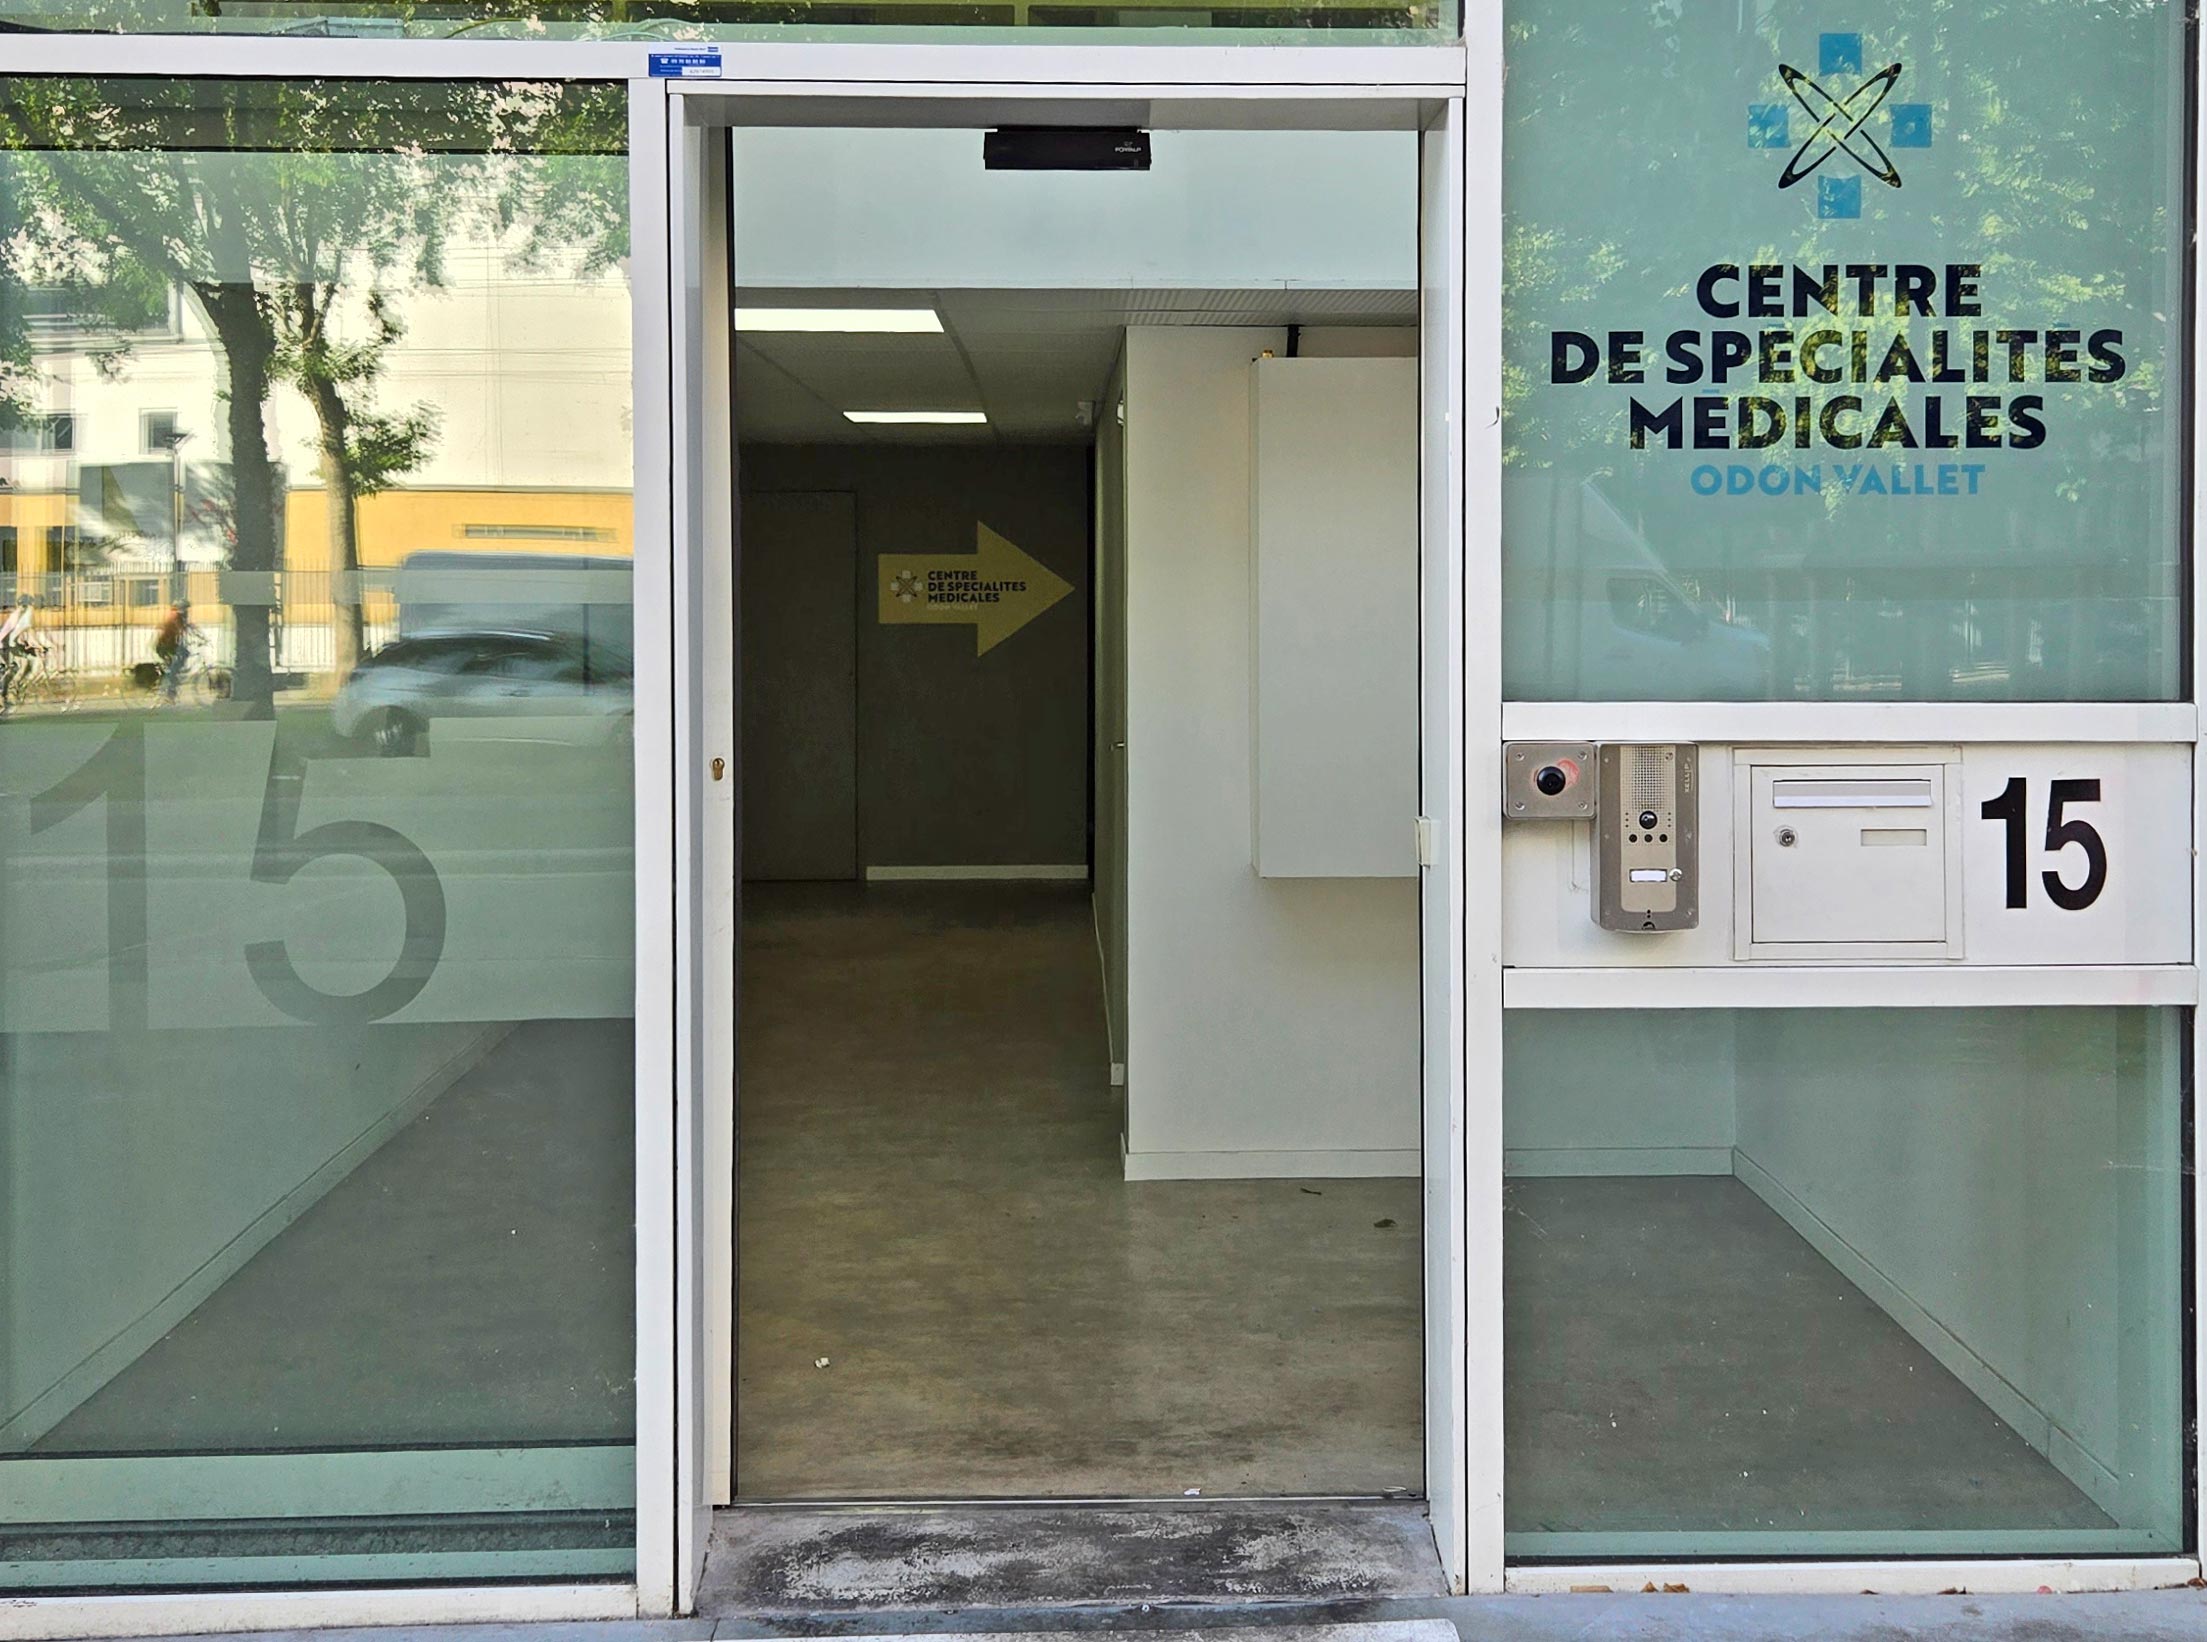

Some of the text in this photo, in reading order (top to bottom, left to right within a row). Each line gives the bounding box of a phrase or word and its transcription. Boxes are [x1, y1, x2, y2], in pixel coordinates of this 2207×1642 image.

[1697, 264, 1982, 317] CENTRE
[1551, 331, 1644, 383] DE
[1690, 463, 1986, 496] ODON VALLET
[927, 570, 978, 580] CENTRE
[928, 582, 945, 592] DE
[1981, 777, 2107, 911] 15
[30, 720, 447, 1027] 15
